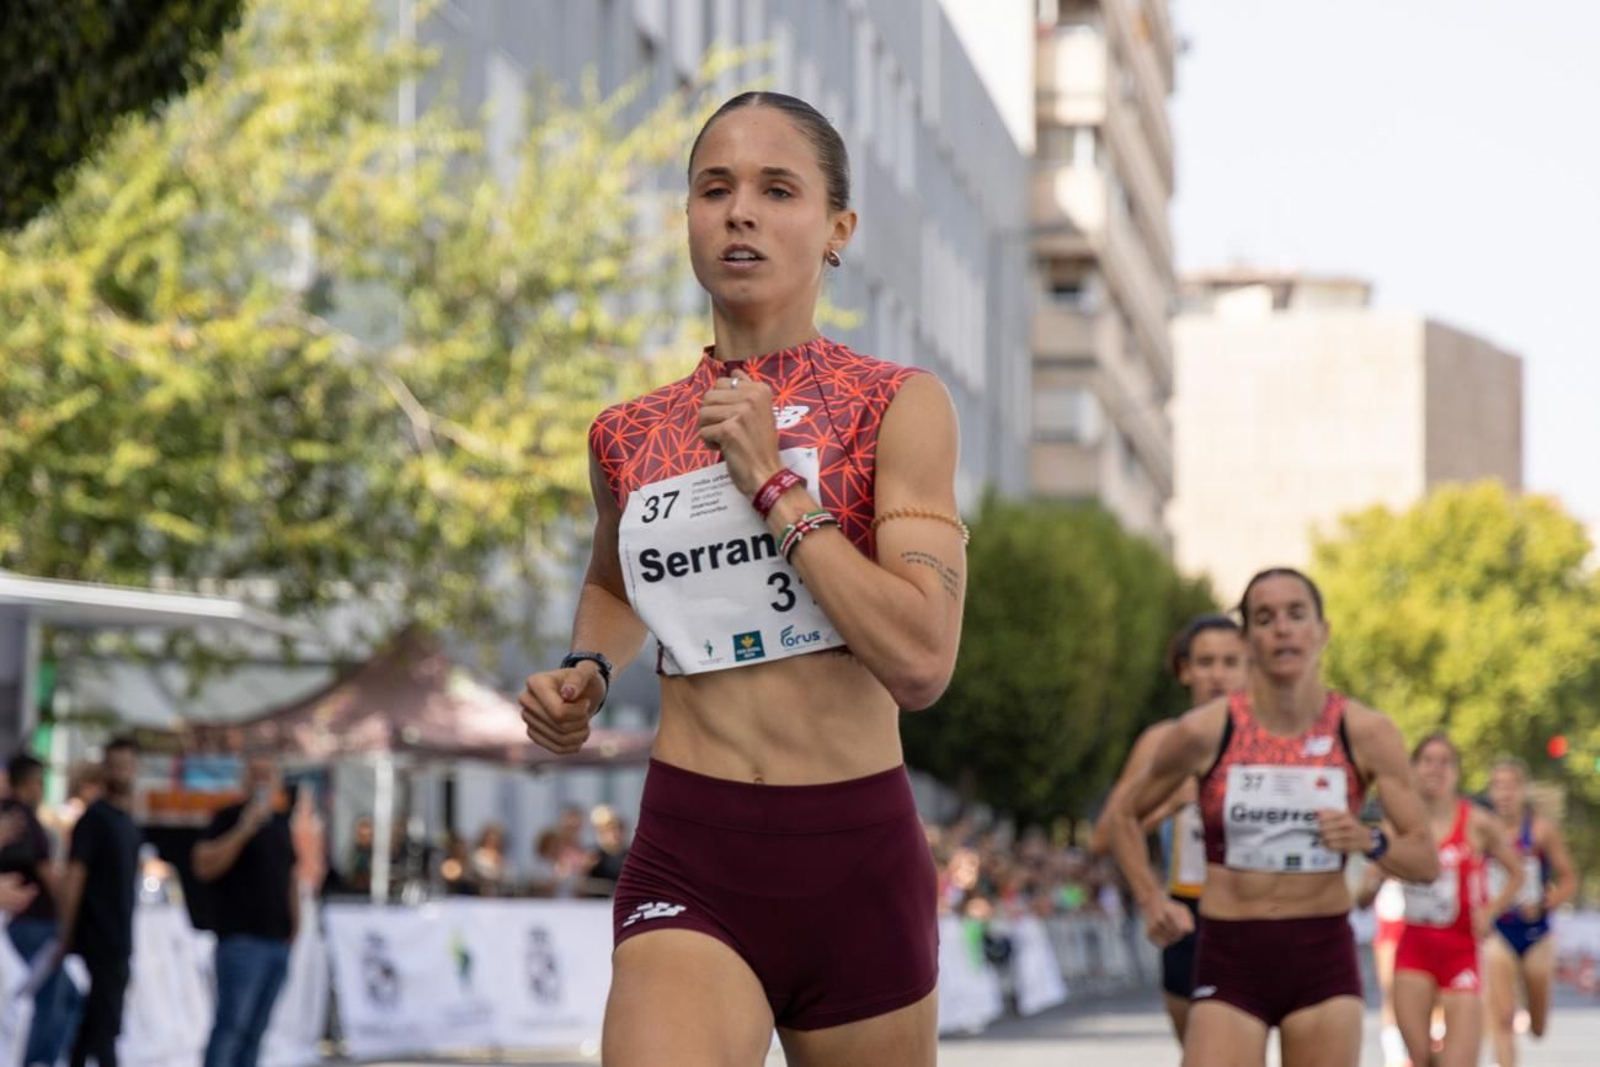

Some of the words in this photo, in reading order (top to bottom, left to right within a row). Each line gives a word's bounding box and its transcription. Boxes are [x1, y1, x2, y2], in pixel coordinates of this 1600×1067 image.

[641, 490, 680, 524] 37
[639, 532, 779, 583] Serran
[767, 572, 804, 612] 3
[780, 624, 821, 648] Forus
[1230, 803, 1320, 824] Guerre
